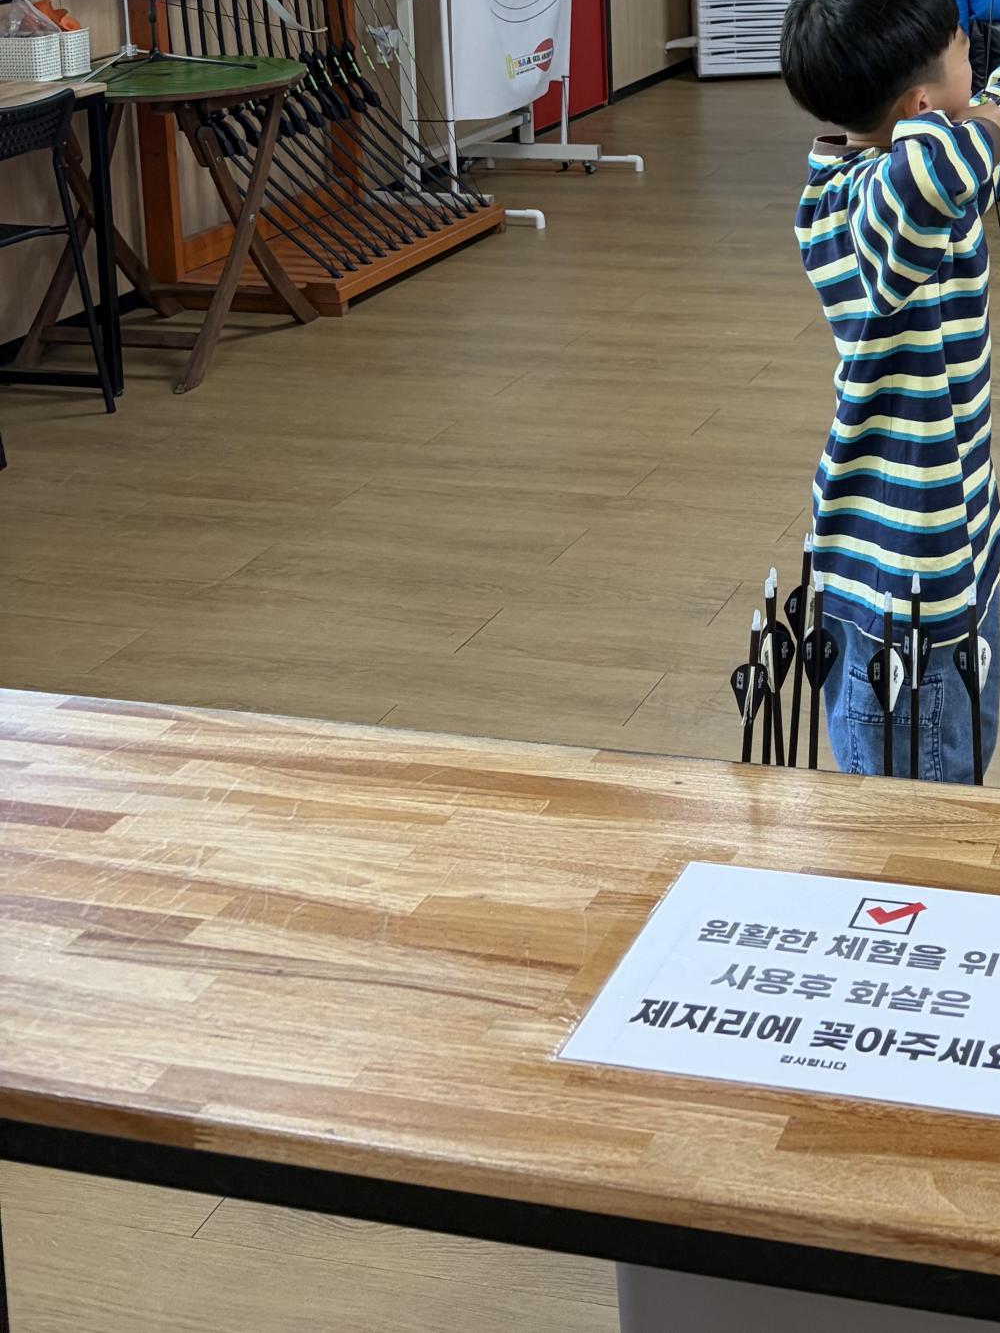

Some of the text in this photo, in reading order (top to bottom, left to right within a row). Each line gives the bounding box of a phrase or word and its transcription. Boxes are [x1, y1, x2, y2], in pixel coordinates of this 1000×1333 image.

[697, 919, 819, 954] 원활한
[824, 934, 947, 971] 체험을
[710, 963, 972, 1018] 사용후 화살은
[628, 998, 803, 1044] 제자리에
[780, 1054, 847, 1071] 감사합니다
